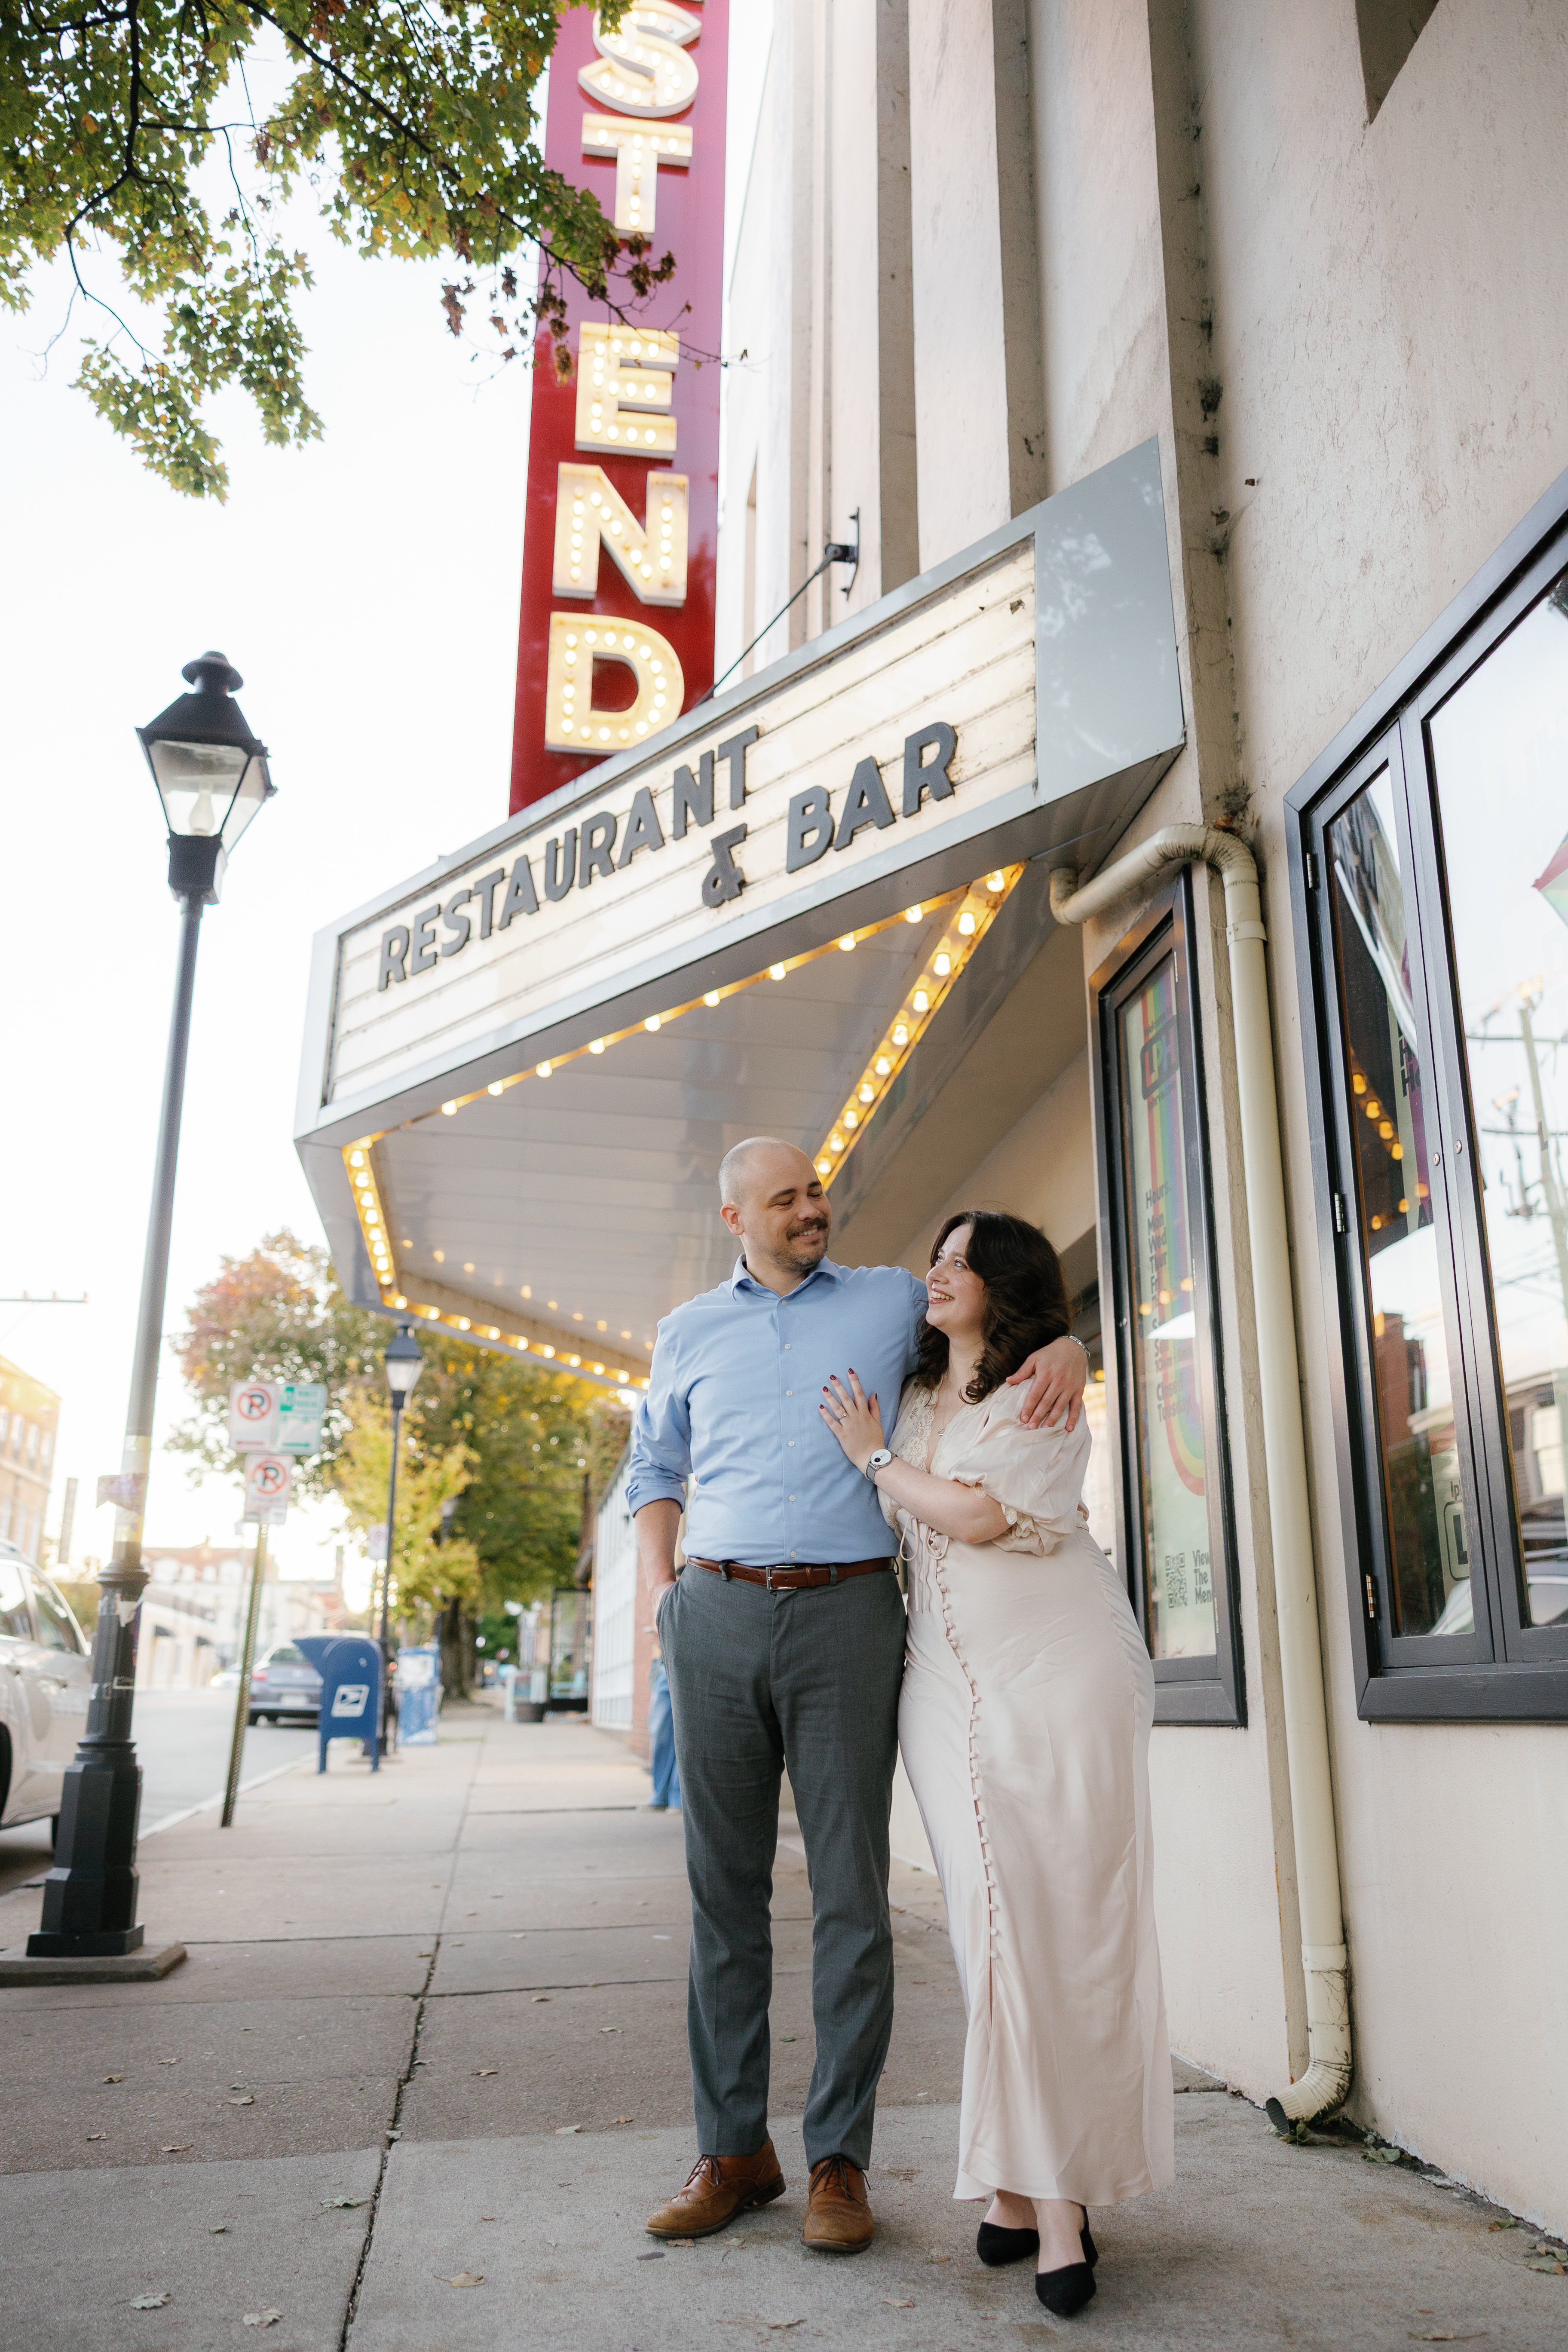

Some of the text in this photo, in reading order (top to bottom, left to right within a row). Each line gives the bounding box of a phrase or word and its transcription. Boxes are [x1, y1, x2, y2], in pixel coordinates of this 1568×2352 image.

[701, 721, 958, 908] & BAR
[378, 725, 759, 992] RESTAURANT
[1145, 1026, 1176, 1088] LPH
[1148, 1214, 1164, 1236] Mon
[1148, 1227, 1167, 1254] Wed
[1157, 1373, 1183, 1402] Closed
[1193, 1550, 1210, 1568] View
[1194, 1568, 1208, 1586] The
